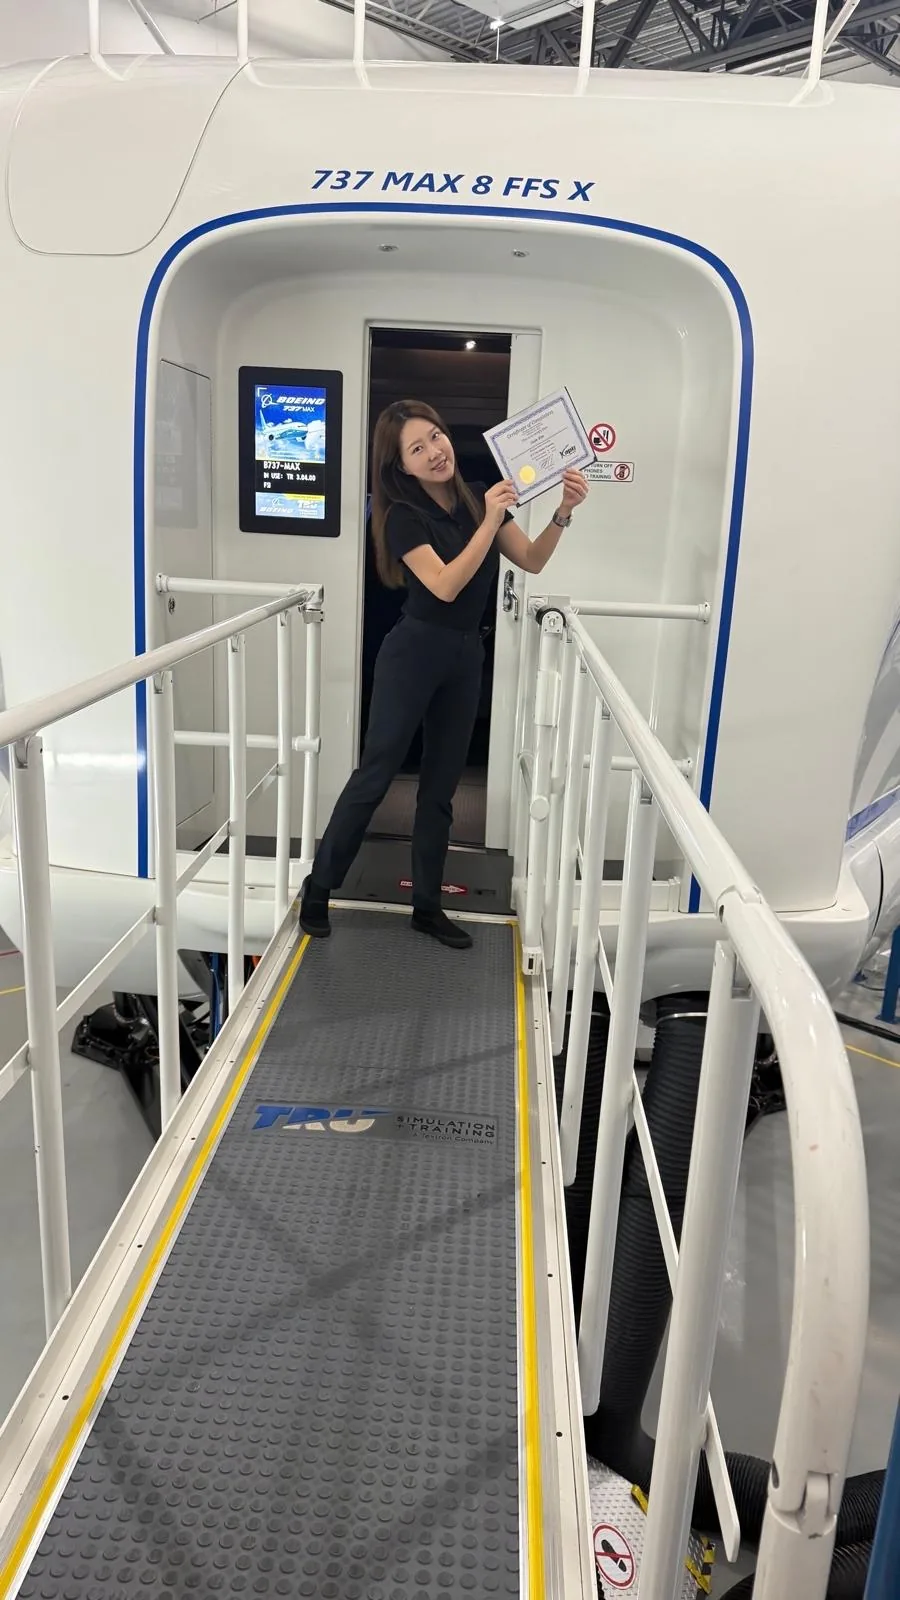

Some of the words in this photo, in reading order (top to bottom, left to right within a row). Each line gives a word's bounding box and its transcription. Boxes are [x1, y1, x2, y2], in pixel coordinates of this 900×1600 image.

[311, 169, 374, 190] 737
[381, 171, 465, 194] MAX
[471, 175, 494, 195] 8
[502, 177, 560, 199] FFS
[567, 180, 596, 202] X
[276, 396, 326, 405] BOEING
[263, 461, 301, 471] B737-MAX
[252, 1104, 395, 1133] TRU
[396, 1116, 495, 1131] SIMULATION
[408, 1123, 495, 1138] TRAINING
